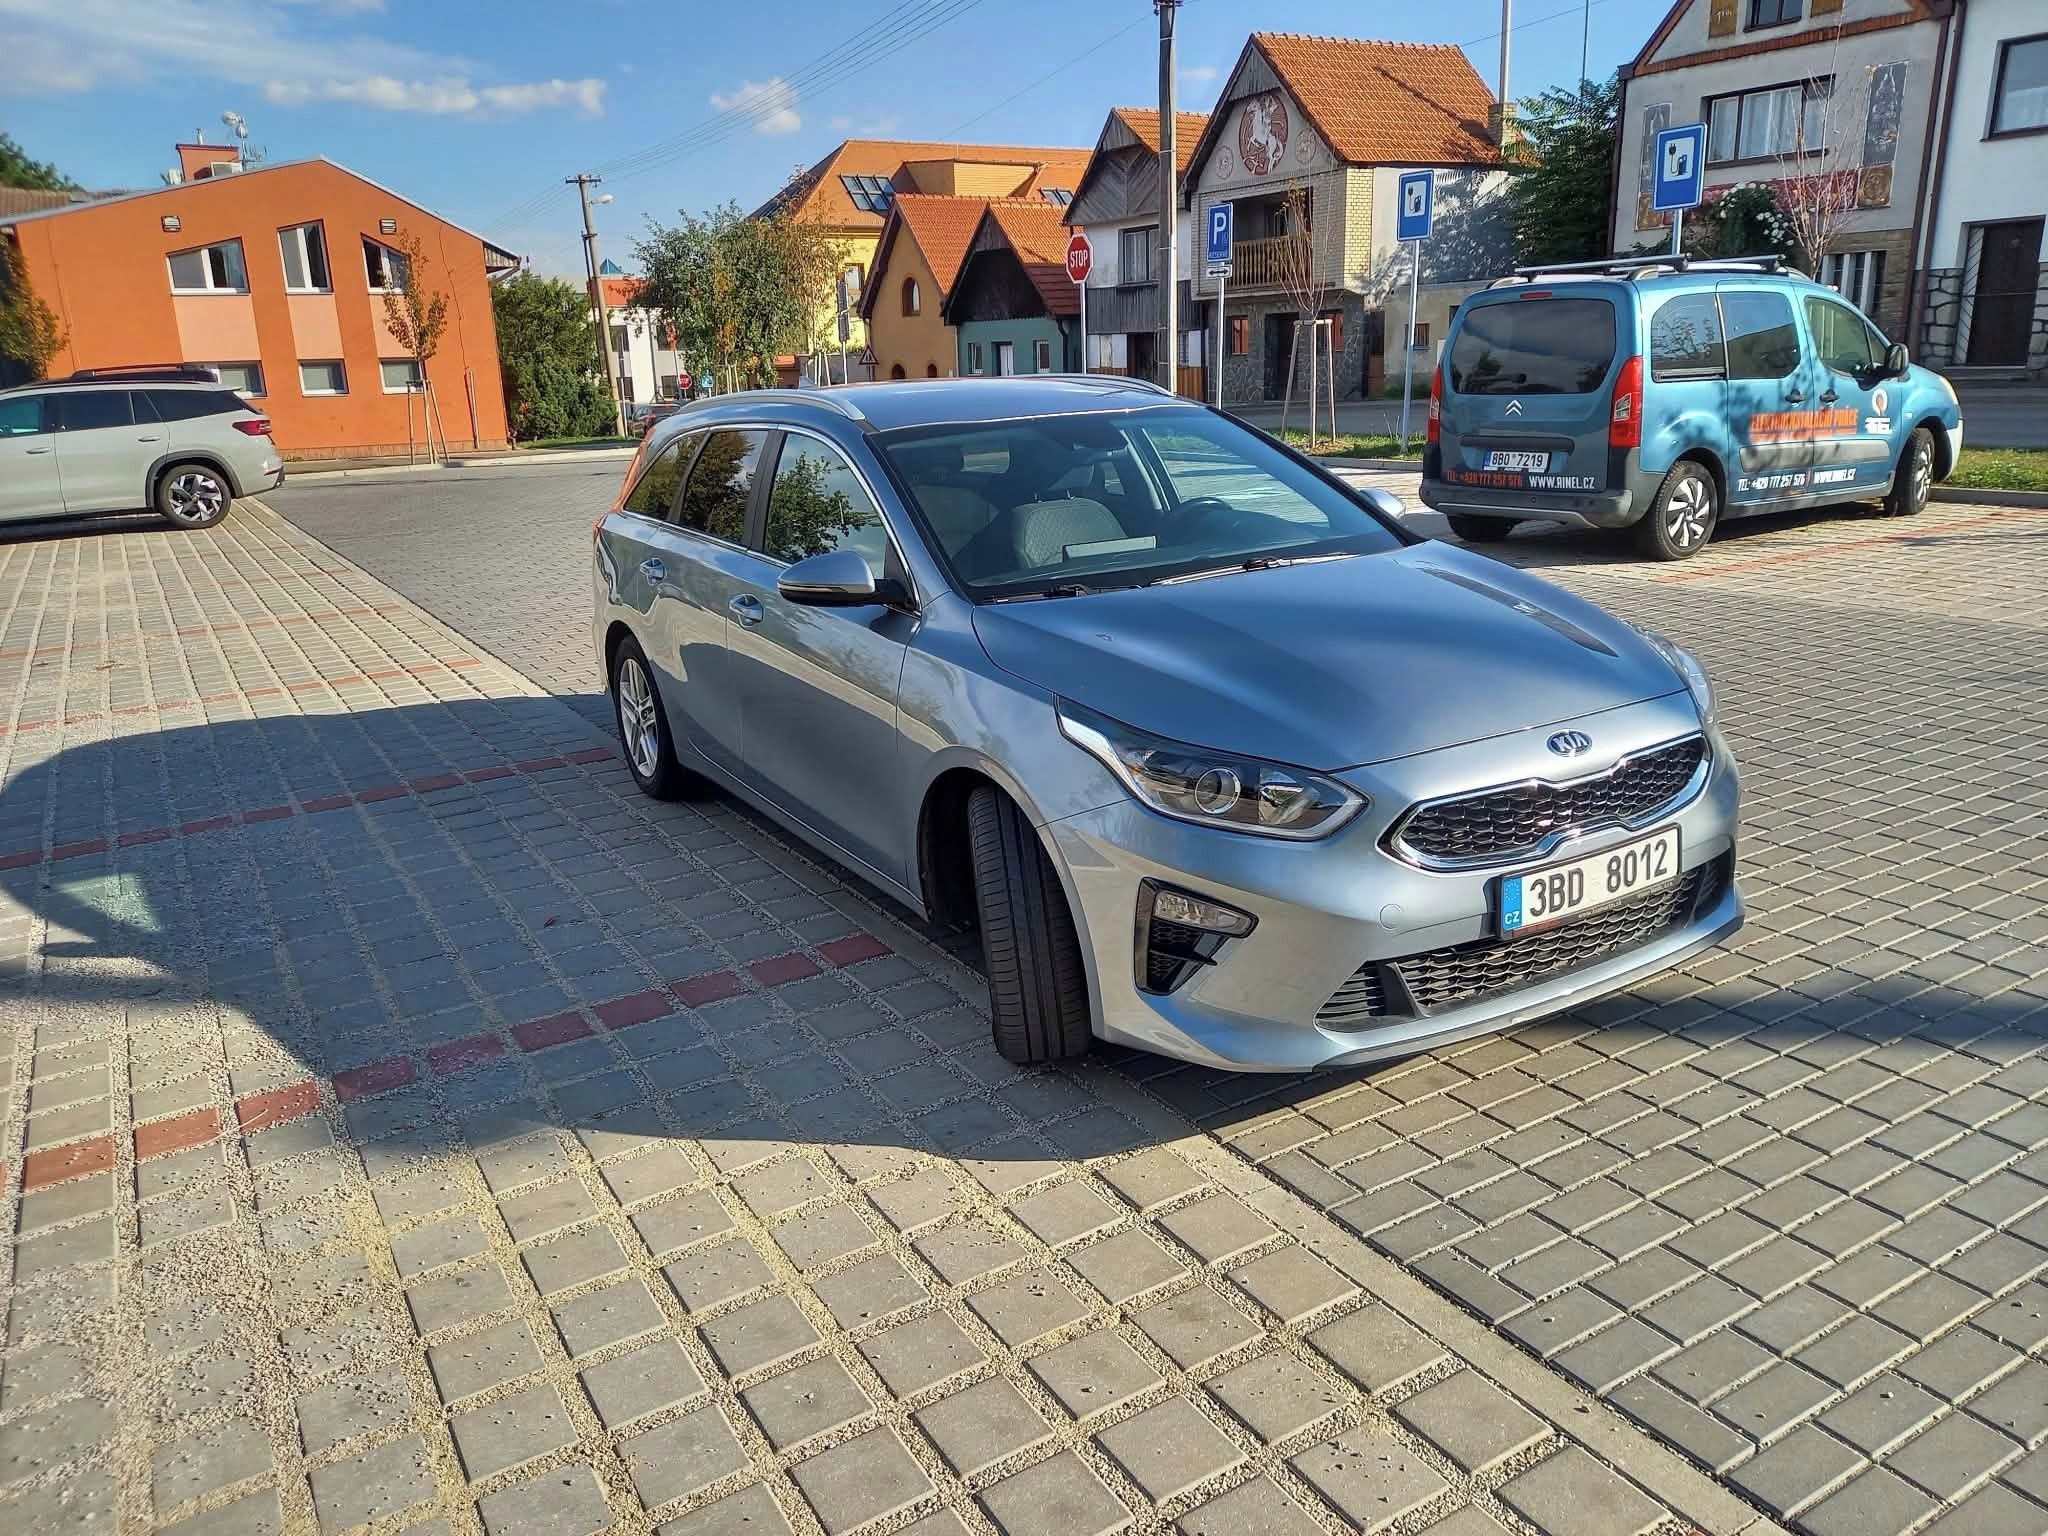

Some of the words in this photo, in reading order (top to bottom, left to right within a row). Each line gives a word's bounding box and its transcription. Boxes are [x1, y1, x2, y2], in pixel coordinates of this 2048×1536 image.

[1213, 212, 1227, 245] P
[1069, 252, 1089, 268] STOP
[1516, 453, 1544, 467] 7219
[1554, 733, 1589, 752] KIA
[1529, 866, 1584, 917] 3BD
[1606, 839, 1668, 894] 8012
[1504, 910, 1521, 925] CZ
